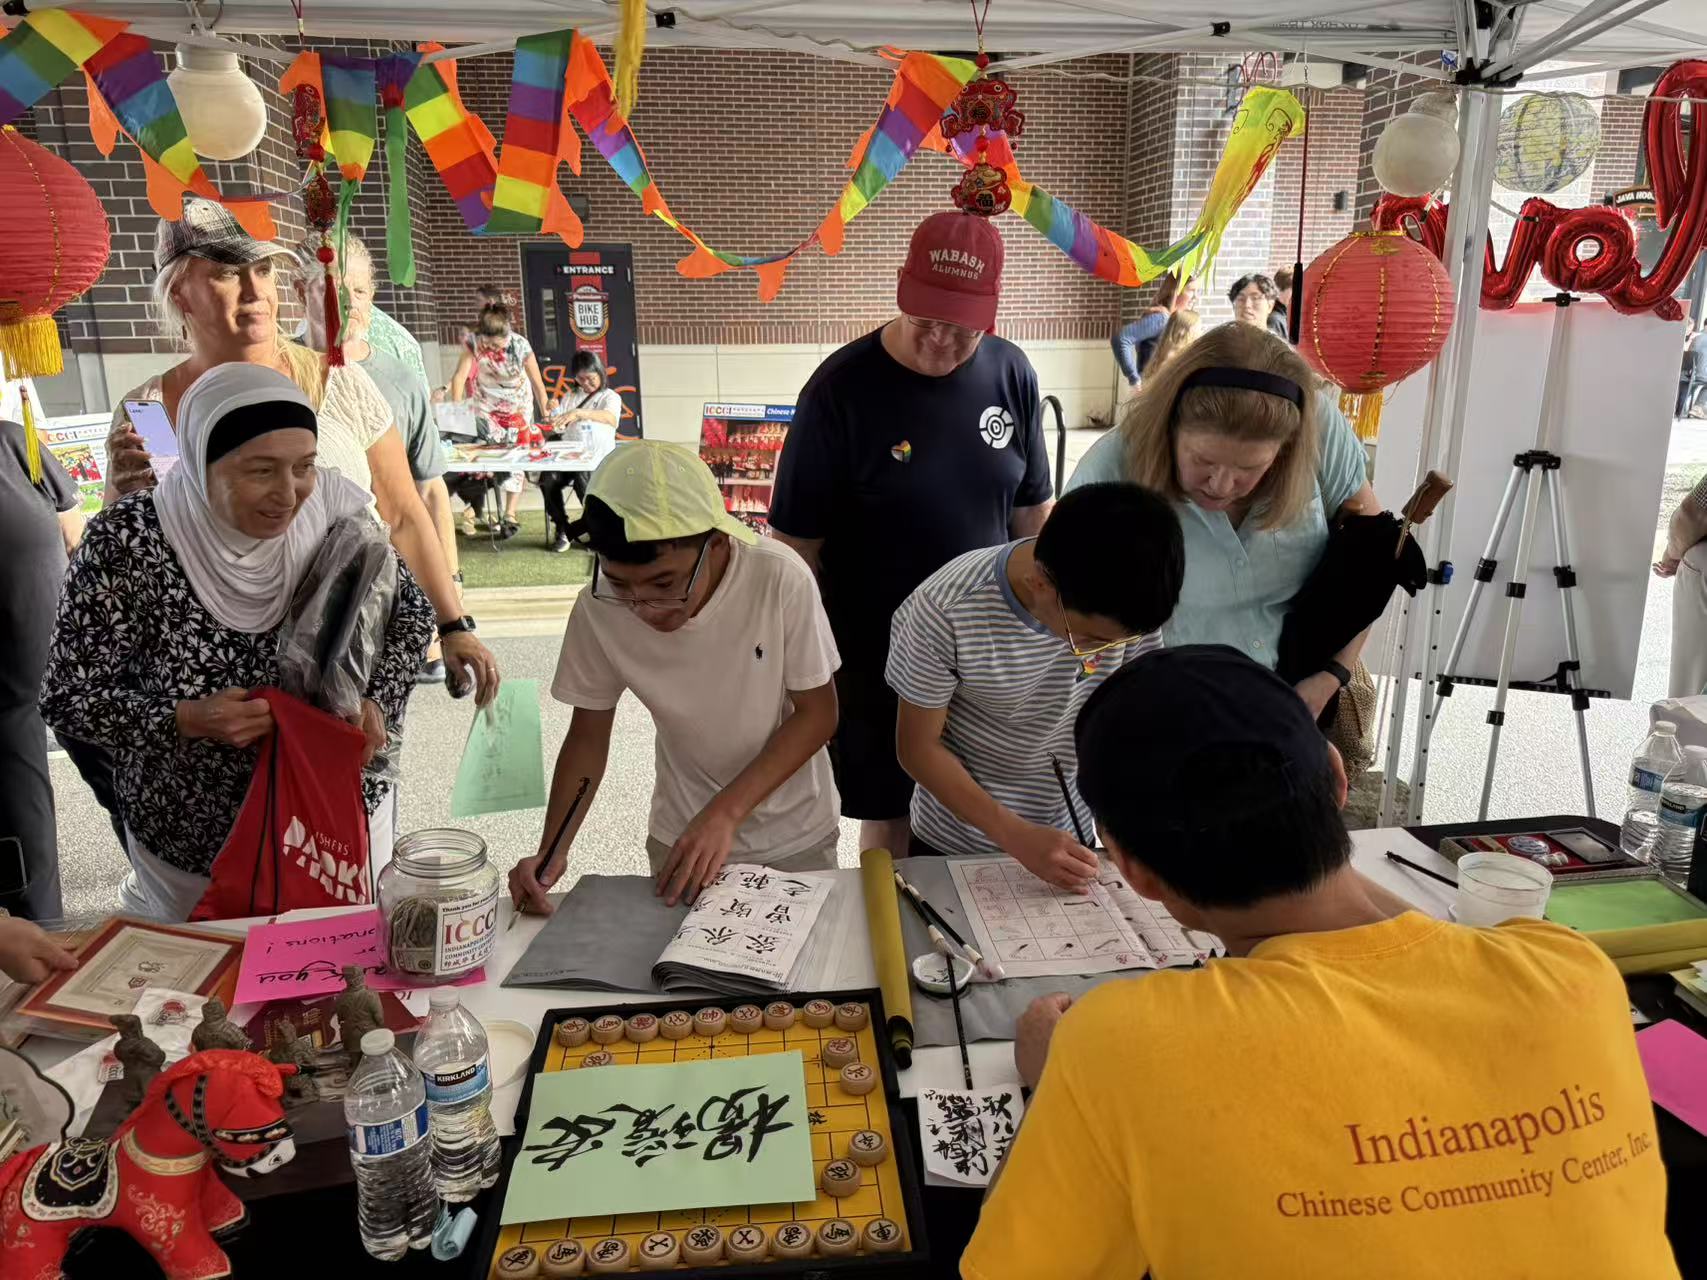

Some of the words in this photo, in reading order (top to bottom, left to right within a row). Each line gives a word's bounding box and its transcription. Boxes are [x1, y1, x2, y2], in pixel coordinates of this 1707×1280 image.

[1616, 192, 1635, 203] JAVA
[928, 248, 985, 274] WABASH
[563, 266, 614, 275] ENTRANCE
[932, 263, 979, 280] ALUMNUS
[577, 303, 600, 315] BIKE
[579, 315, 600, 326] HUB
[766, 408, 790, 417] Chinese
[436, 1066, 476, 1083] KIRKLAND
[1343, 1084, 1605, 1165] Indianapolis
[1276, 1190, 1393, 1218] Chinese
[1400, 1168, 1553, 1212] Community
[1561, 1146, 1628, 1185] Center,
